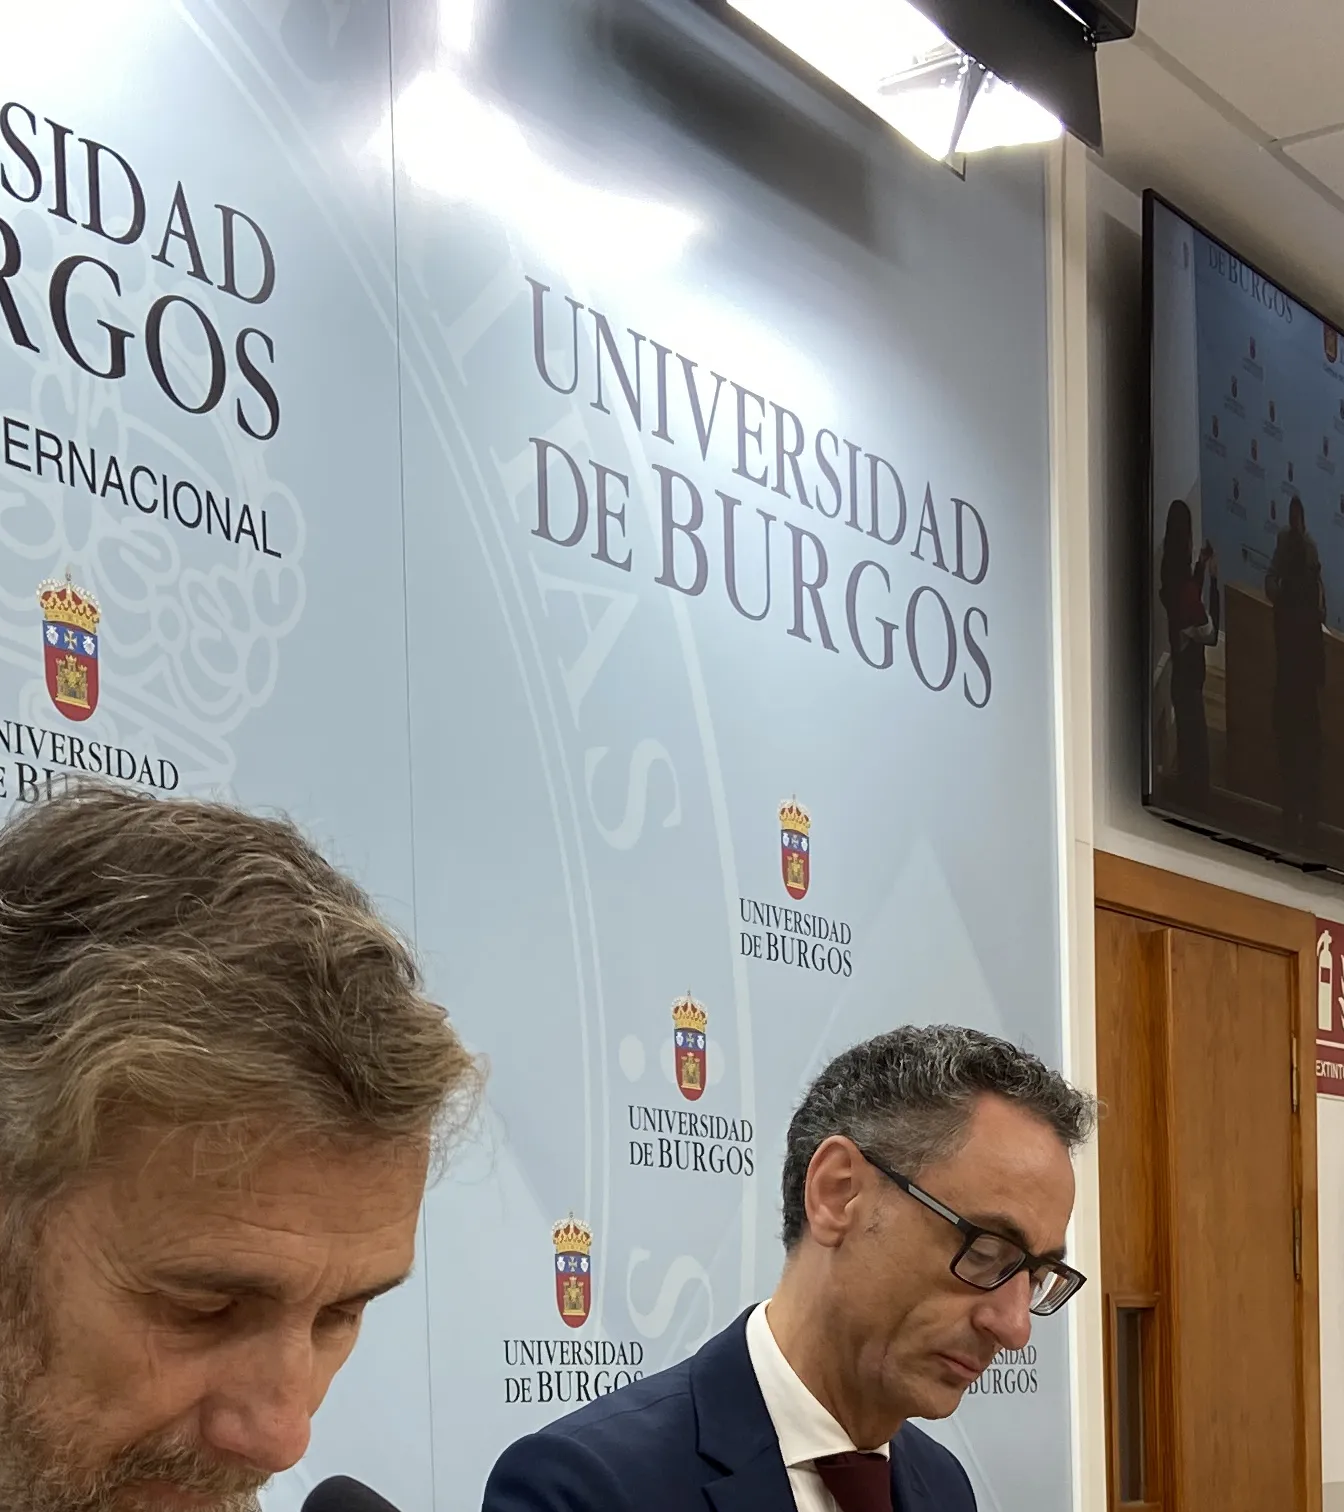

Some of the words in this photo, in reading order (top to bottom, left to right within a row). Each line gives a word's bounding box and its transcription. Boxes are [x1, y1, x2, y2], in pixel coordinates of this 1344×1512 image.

[525, 276, 990, 586] UNIVERSIDAD
[528, 437, 632, 572] DE
[651, 463, 993, 709] BURGOS
[739, 897, 852, 945] UNIVERSIDAD
[740, 932, 762, 959] DE
[766, 931, 852, 978] BURGOS
[628, 1104, 754, 1143] UNIVERSIDAD
[629, 1141, 654, 1167] DE
[658, 1137, 754, 1177] BURGOS
[503, 1339, 644, 1366] UNIVERSIDAD
[505, 1377, 532, 1403] DE
